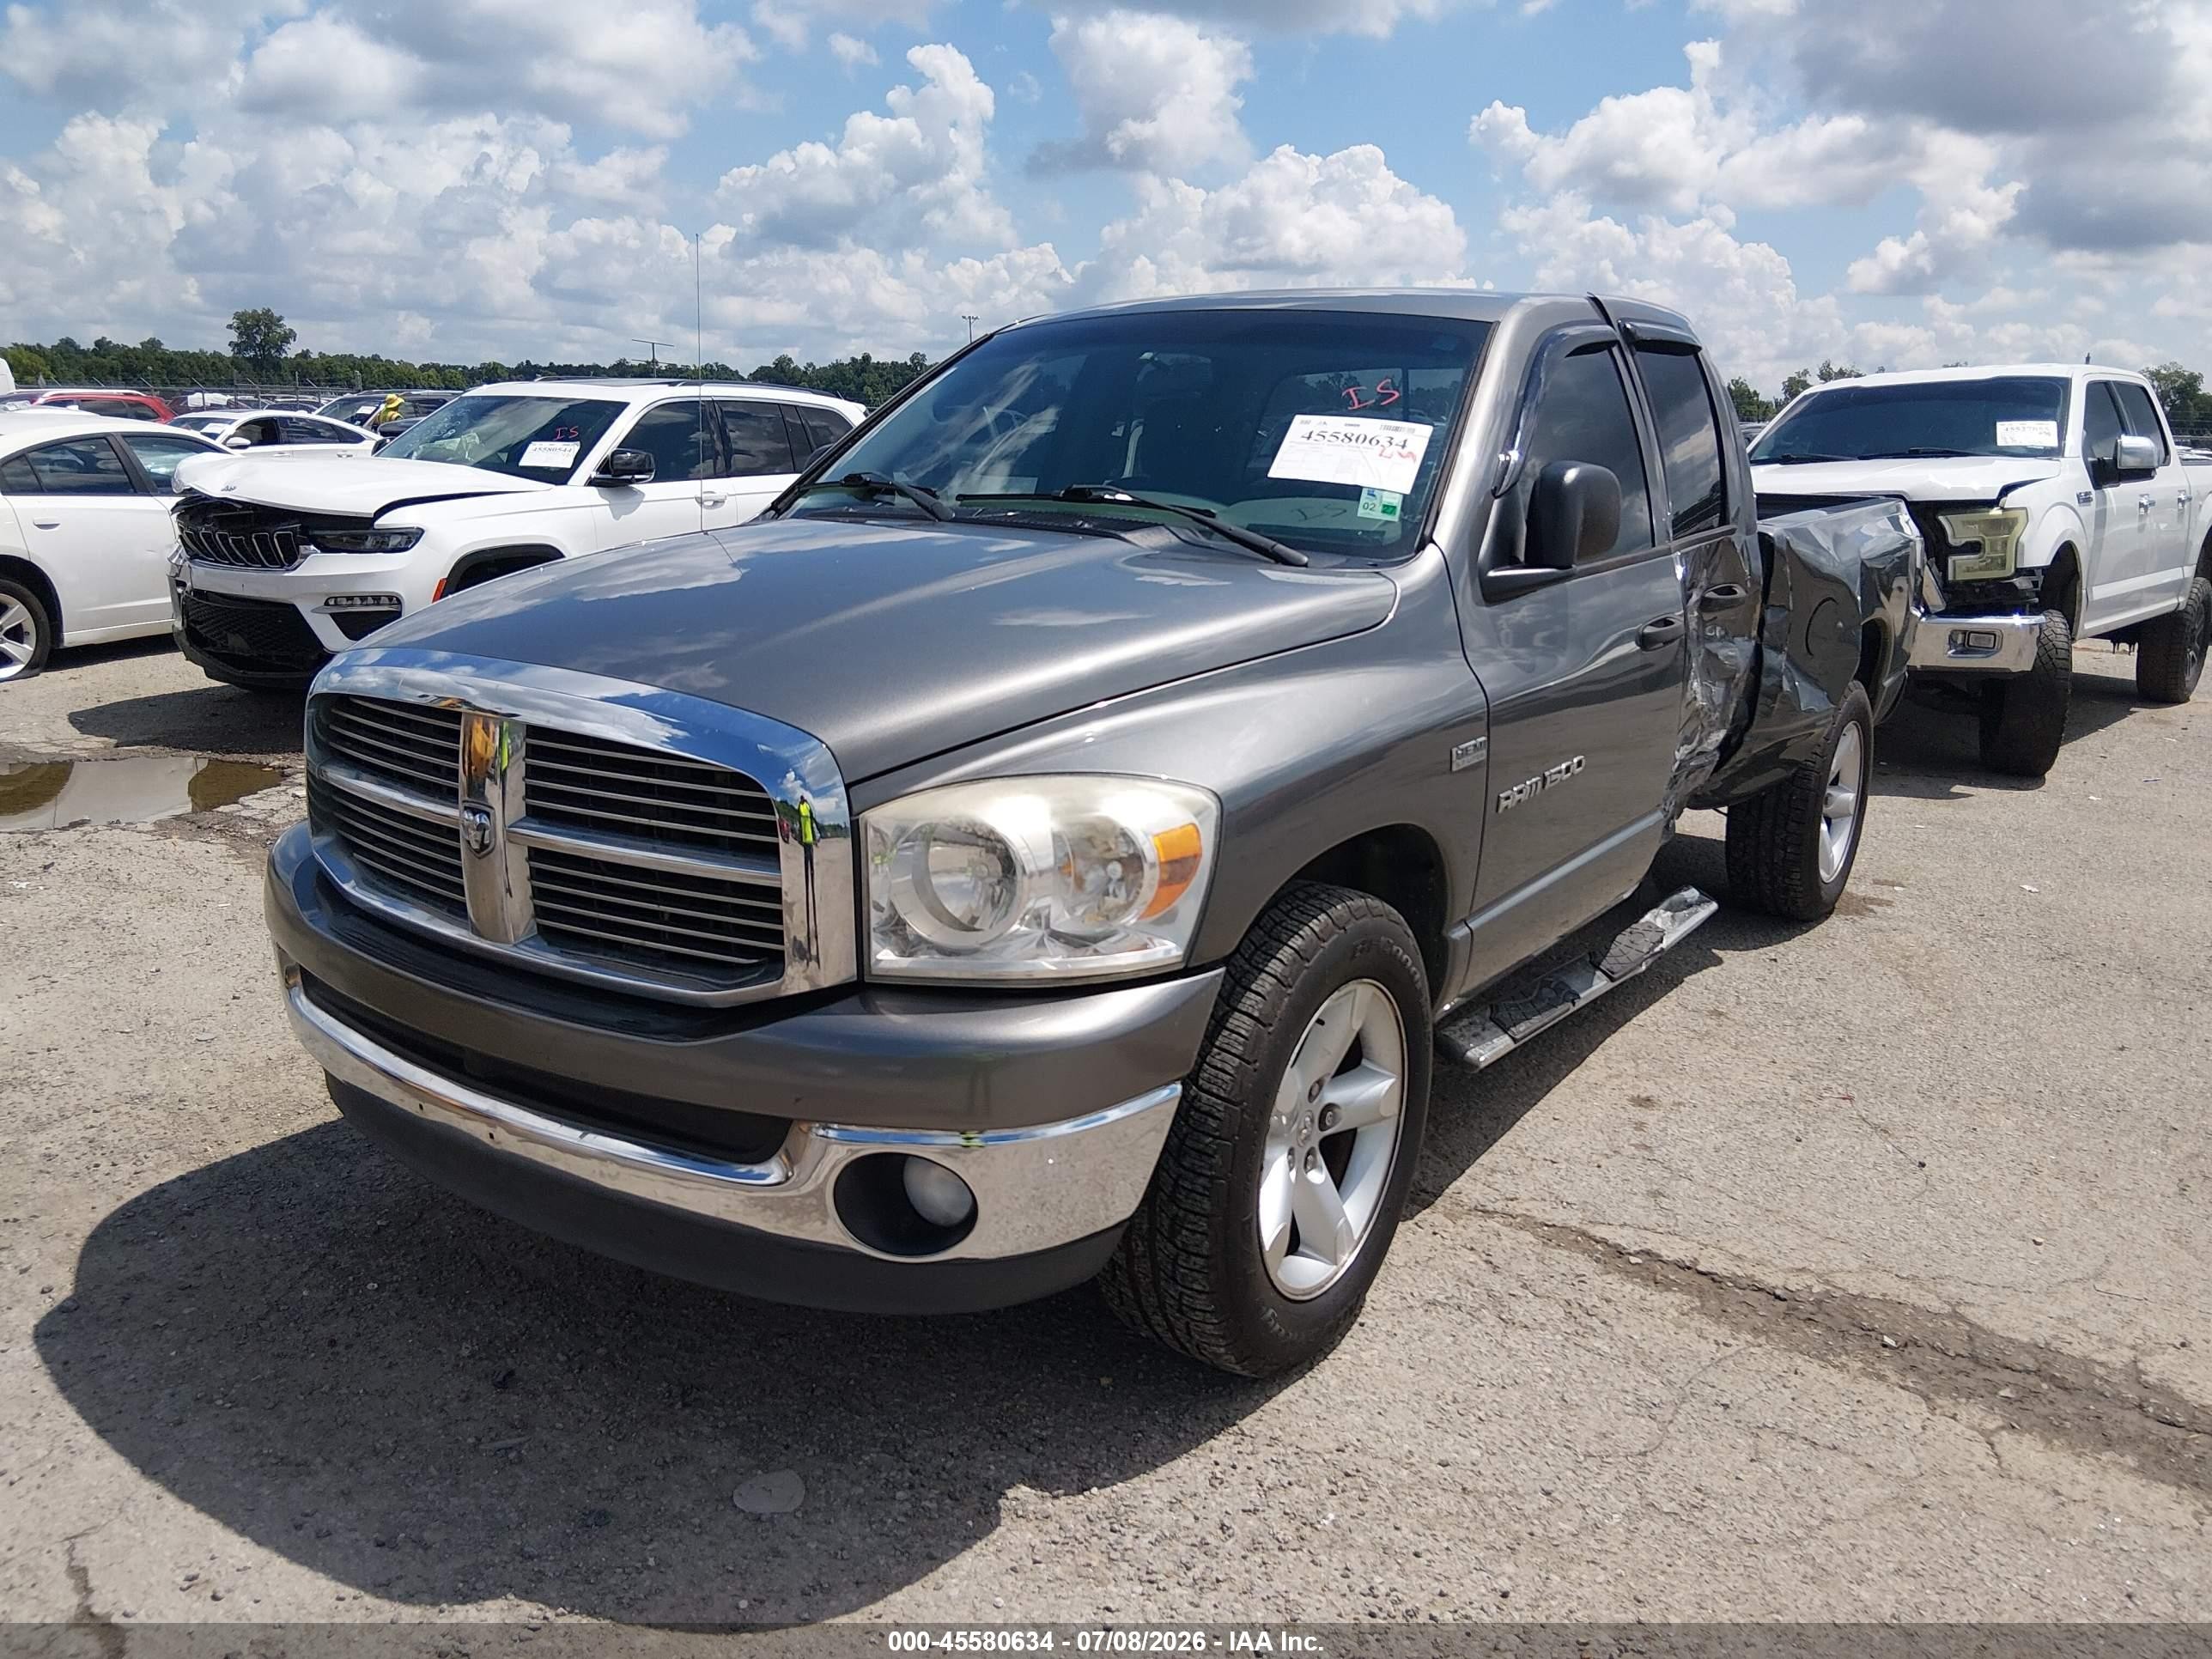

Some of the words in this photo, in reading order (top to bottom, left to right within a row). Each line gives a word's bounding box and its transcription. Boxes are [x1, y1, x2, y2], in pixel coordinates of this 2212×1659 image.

[1341, 378, 1401, 410] IS
[1301, 430, 1409, 450] 45580634
[1362, 501, 1376, 512] 02
[1382, 504, 1396, 515] 27
[1497, 776, 1541, 813] RAM
[1543, 755, 1586, 790] 1500
